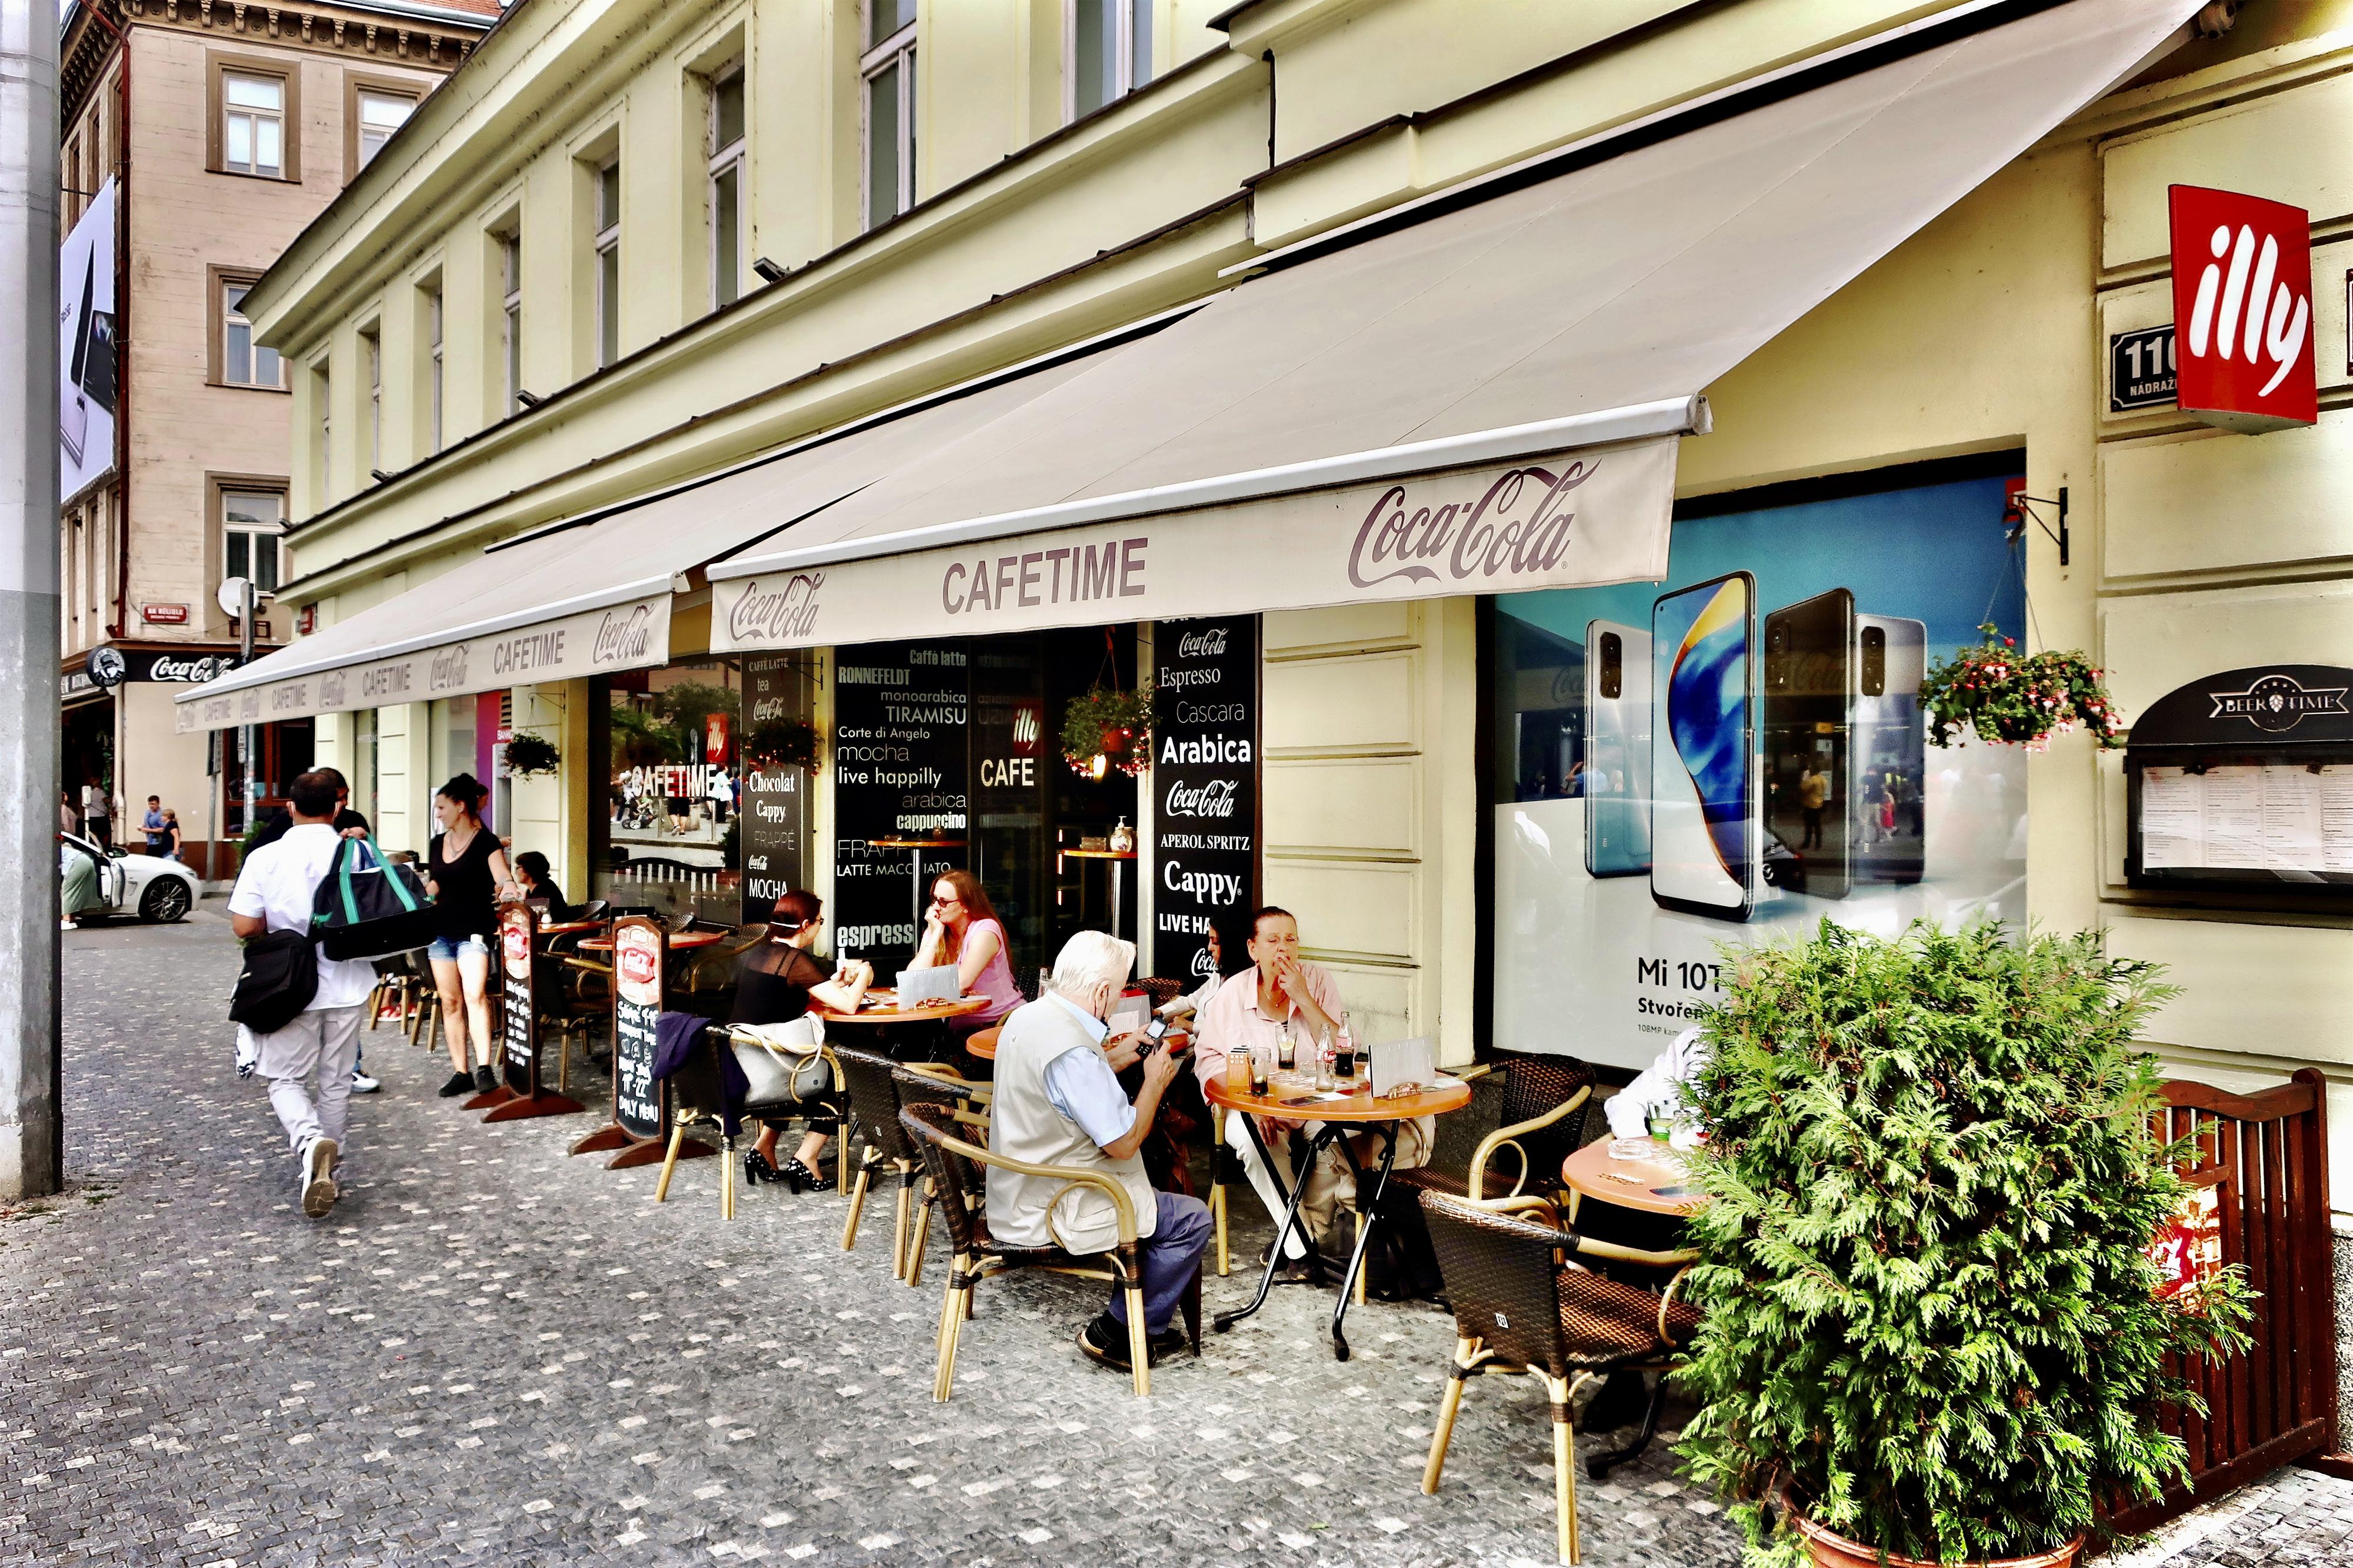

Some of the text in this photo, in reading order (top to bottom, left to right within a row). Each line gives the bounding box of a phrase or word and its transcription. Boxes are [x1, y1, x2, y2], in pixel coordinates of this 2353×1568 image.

[2189, 224, 2308, 397] illy
[1348, 457, 1602, 588] Coca-Cola
[942, 538, 1148, 614] CAFETIME
[729, 572, 826, 641] Coca-Cola
[493, 630, 565, 675] CAFETIME
[768, 657, 788, 669] LATTE
[910, 649, 938, 665] Caffè
[941, 650, 966, 666] latte
[362, 663, 411, 696] CAFETIME
[757, 678, 769, 692] tea
[838, 666, 910, 685] RONNEFELDT
[1161, 667, 1221, 692] Espresso
[881, 689, 966, 703] monoarabica
[2226, 695, 2334, 712] BEER TIME
[885, 706, 966, 725] TIRAMISU
[1176, 701, 1244, 723] Cascara
[838, 726, 930, 741] Corte di Angelo
[1014, 708, 1040, 750] illy
[838, 743, 909, 761] mocha
[1161, 733, 1251, 764] Arabica
[631, 764, 717, 798] CAFETIME
[749, 772, 795, 792] Chocolat
[839, 766, 941, 789] live happilly
[981, 758, 1034, 786] CAFE
[902, 792, 966, 808] arabica
[1166, 780, 1239, 817] Coca-Cola
[756, 800, 786, 823] Cappy
[896, 812, 966, 832] cappuccino
[755, 829, 794, 850] FRAPPÉ
[838, 839, 914, 858] FRAPP
[1161, 834, 1250, 850] APEROL SPRITZ
[836, 862, 951, 876] LATTE MACCIATO
[749, 878, 787, 899] MOCHA
[1164, 860, 1241, 905] Cappy
[1159, 913, 1189, 933] LIVE
[1638, 957, 1722, 993] Mi 10T
[1638, 1024, 1662, 1034] 108MP
